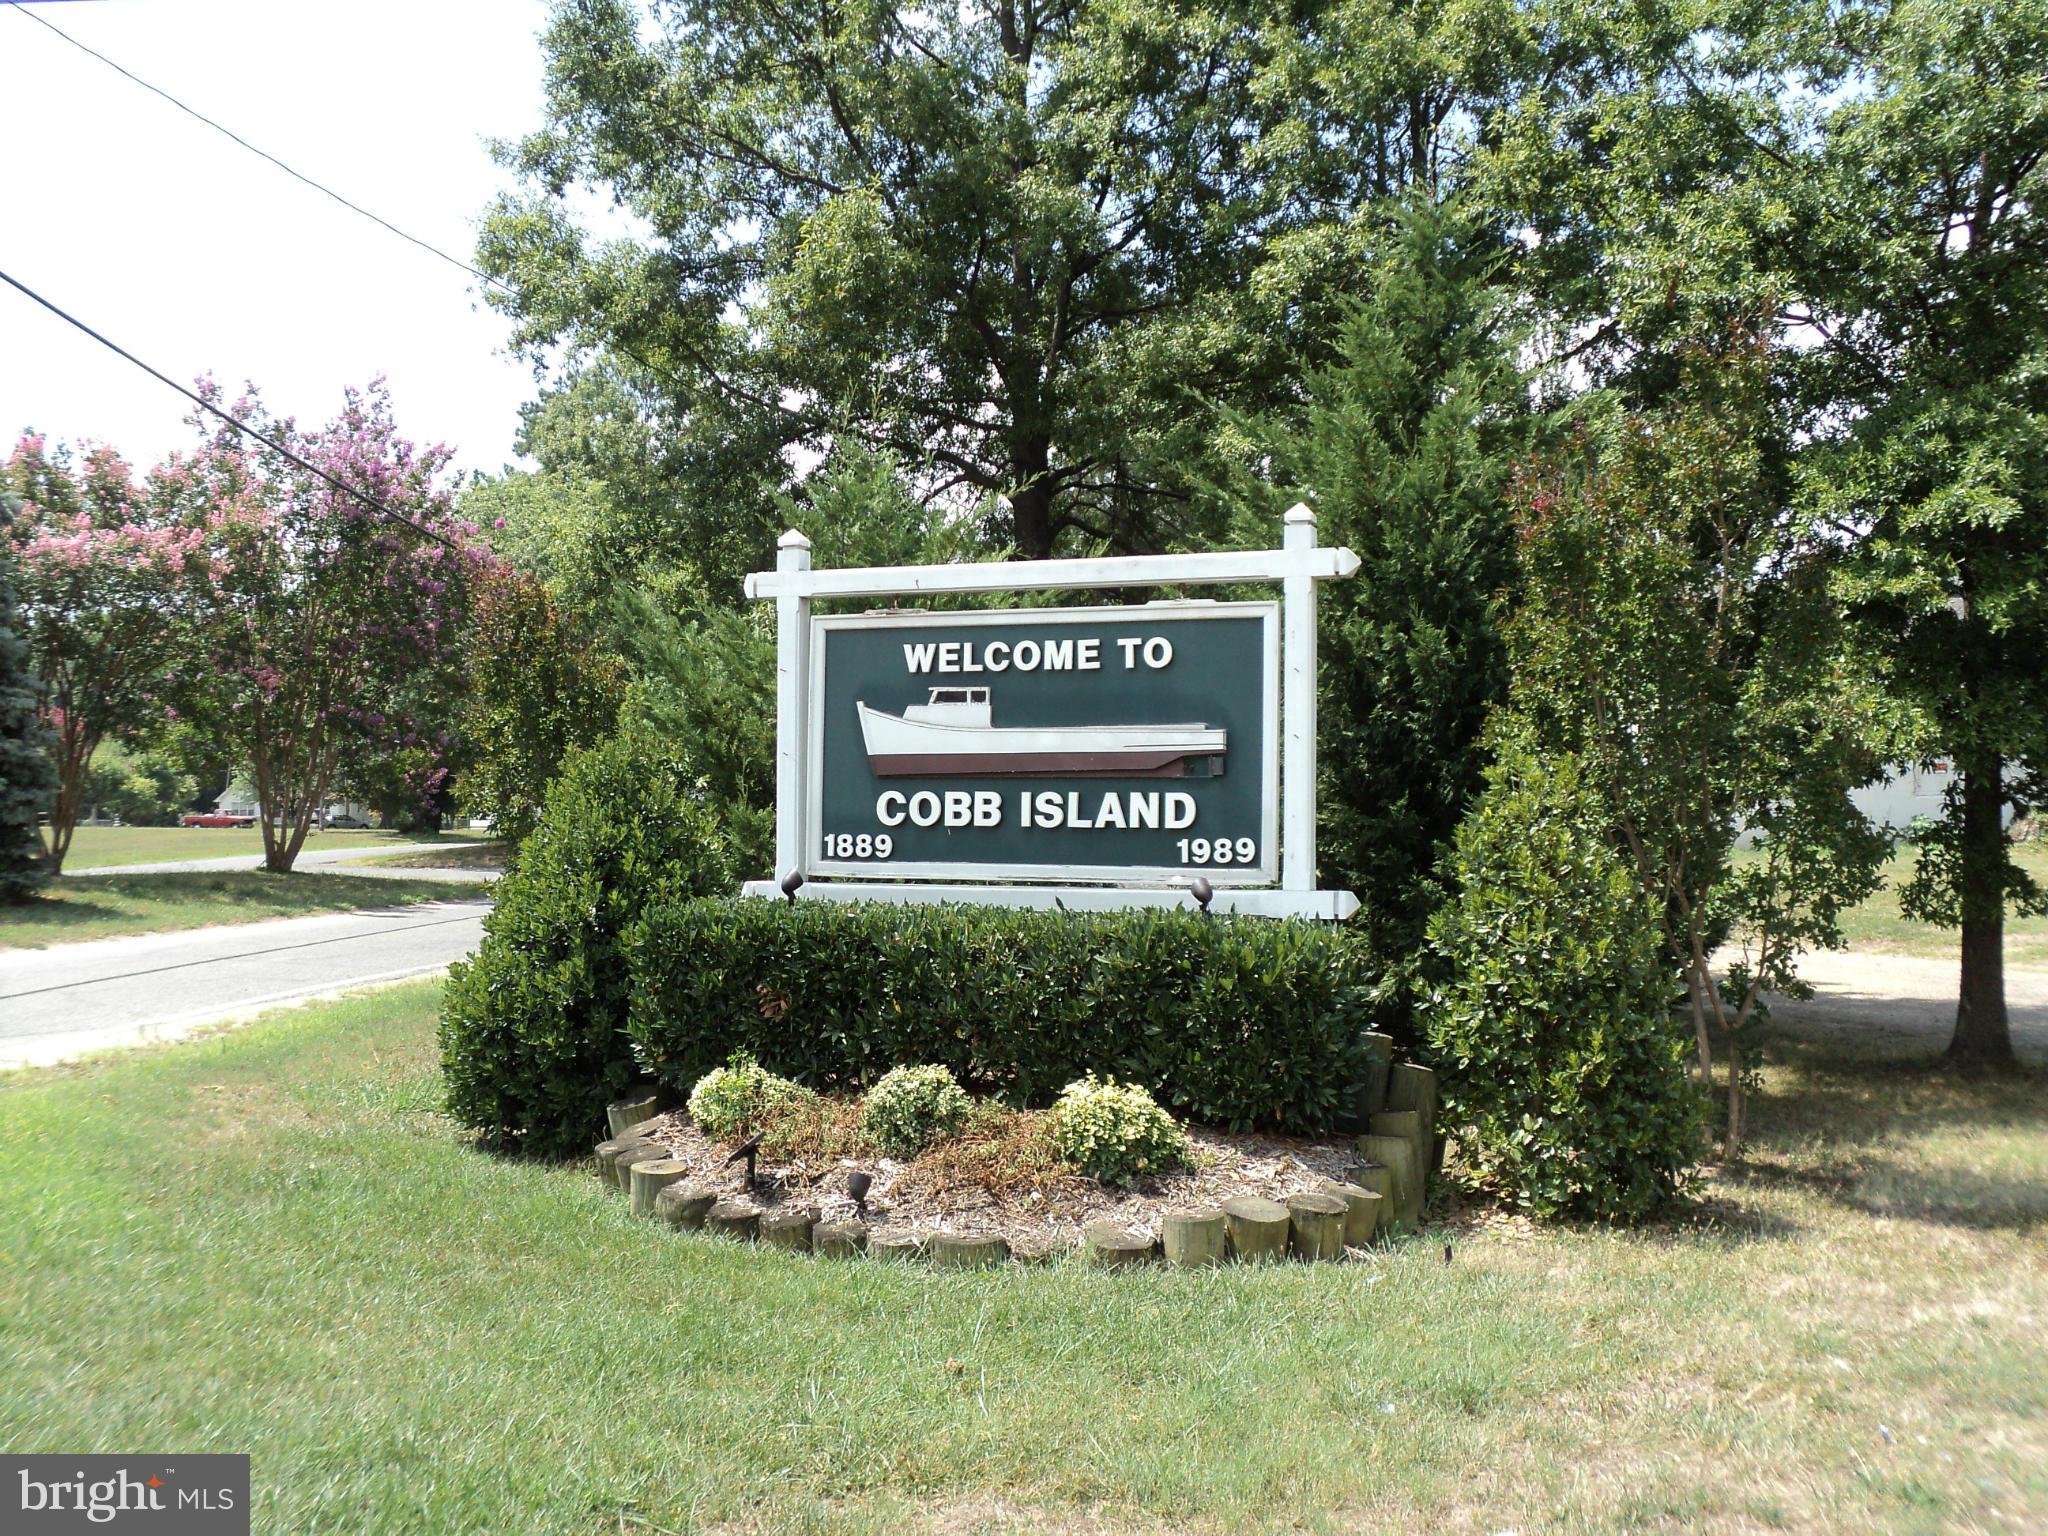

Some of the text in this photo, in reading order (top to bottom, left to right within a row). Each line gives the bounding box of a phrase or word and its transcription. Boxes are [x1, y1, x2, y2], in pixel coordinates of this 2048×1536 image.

[903, 636, 1174, 674] WELCOME TO
[876, 790, 1197, 830] COBB ISLAND
[823, 834, 893, 860] 1889
[1177, 837, 1256, 864] 1989
